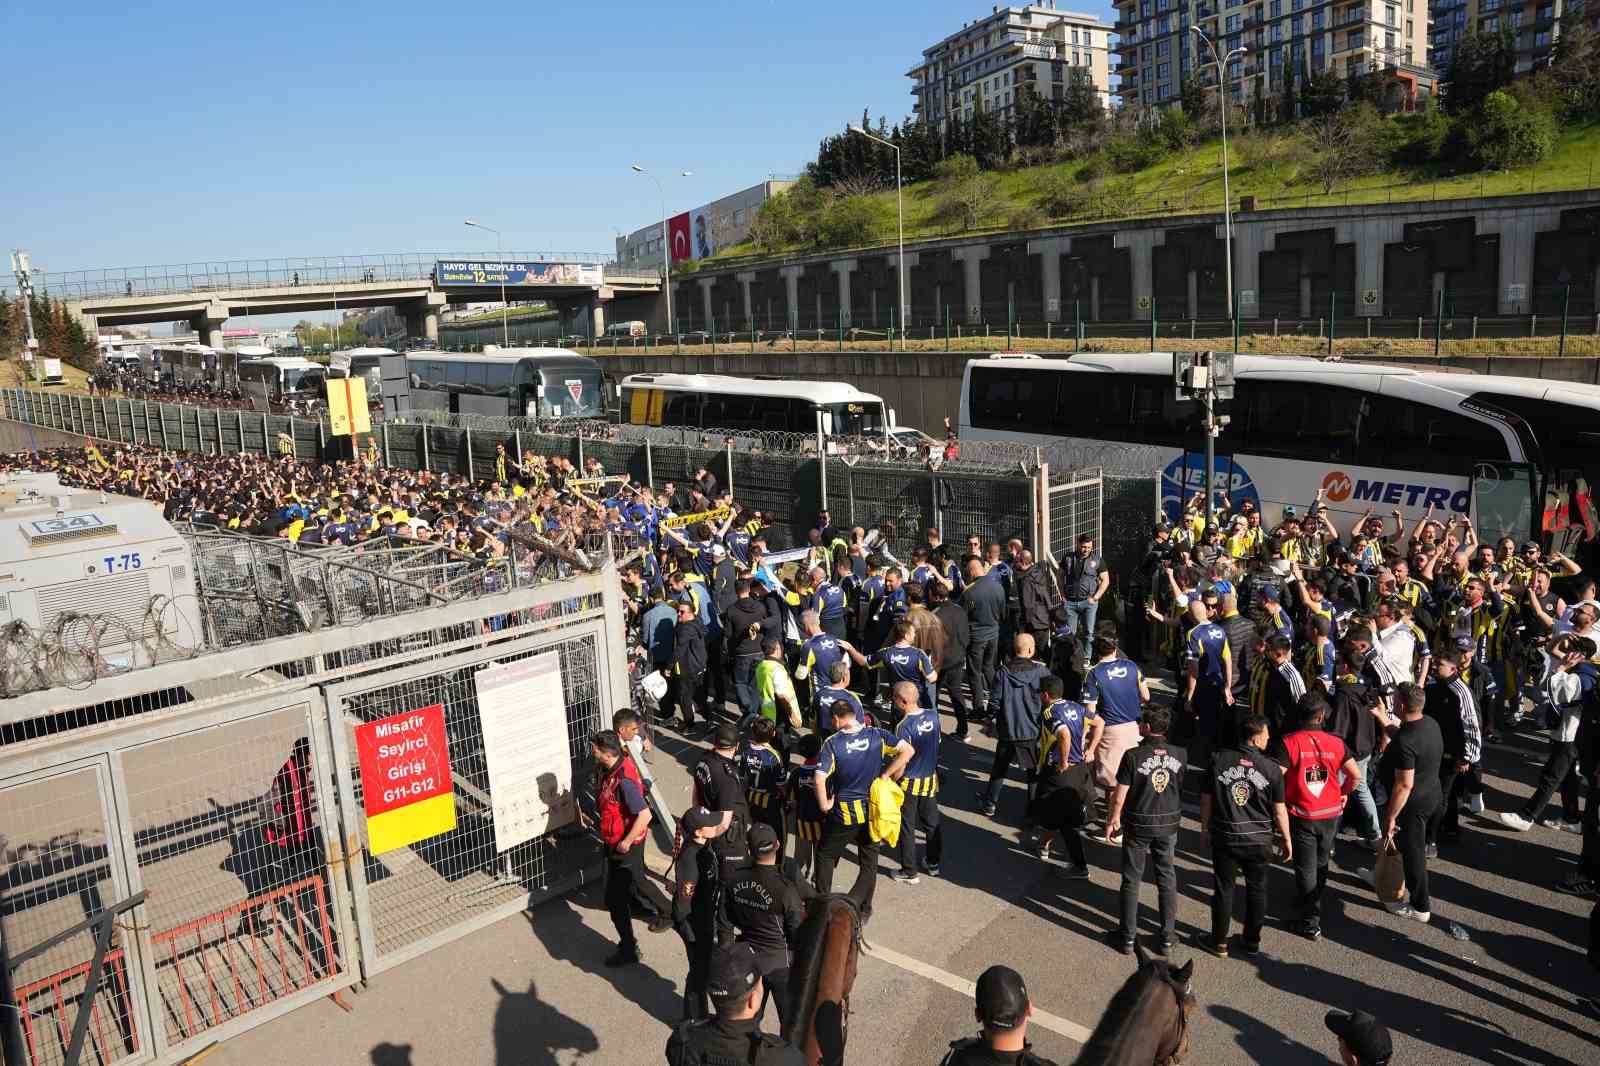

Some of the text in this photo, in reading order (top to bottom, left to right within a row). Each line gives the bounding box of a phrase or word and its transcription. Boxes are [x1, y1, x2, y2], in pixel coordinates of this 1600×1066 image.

[473, 271, 486, 283] 12
[1171, 466, 1244, 488] MERO
[1352, 479, 1471, 513] METRO
[46, 517, 90, 531] 34
[104, 552, 142, 574] T-75
[375, 716, 425, 738] Misafir
[378, 736, 428, 759] Seyirci
[387, 760, 427, 780] Girişi
[383, 778, 434, 803] G11-G12
